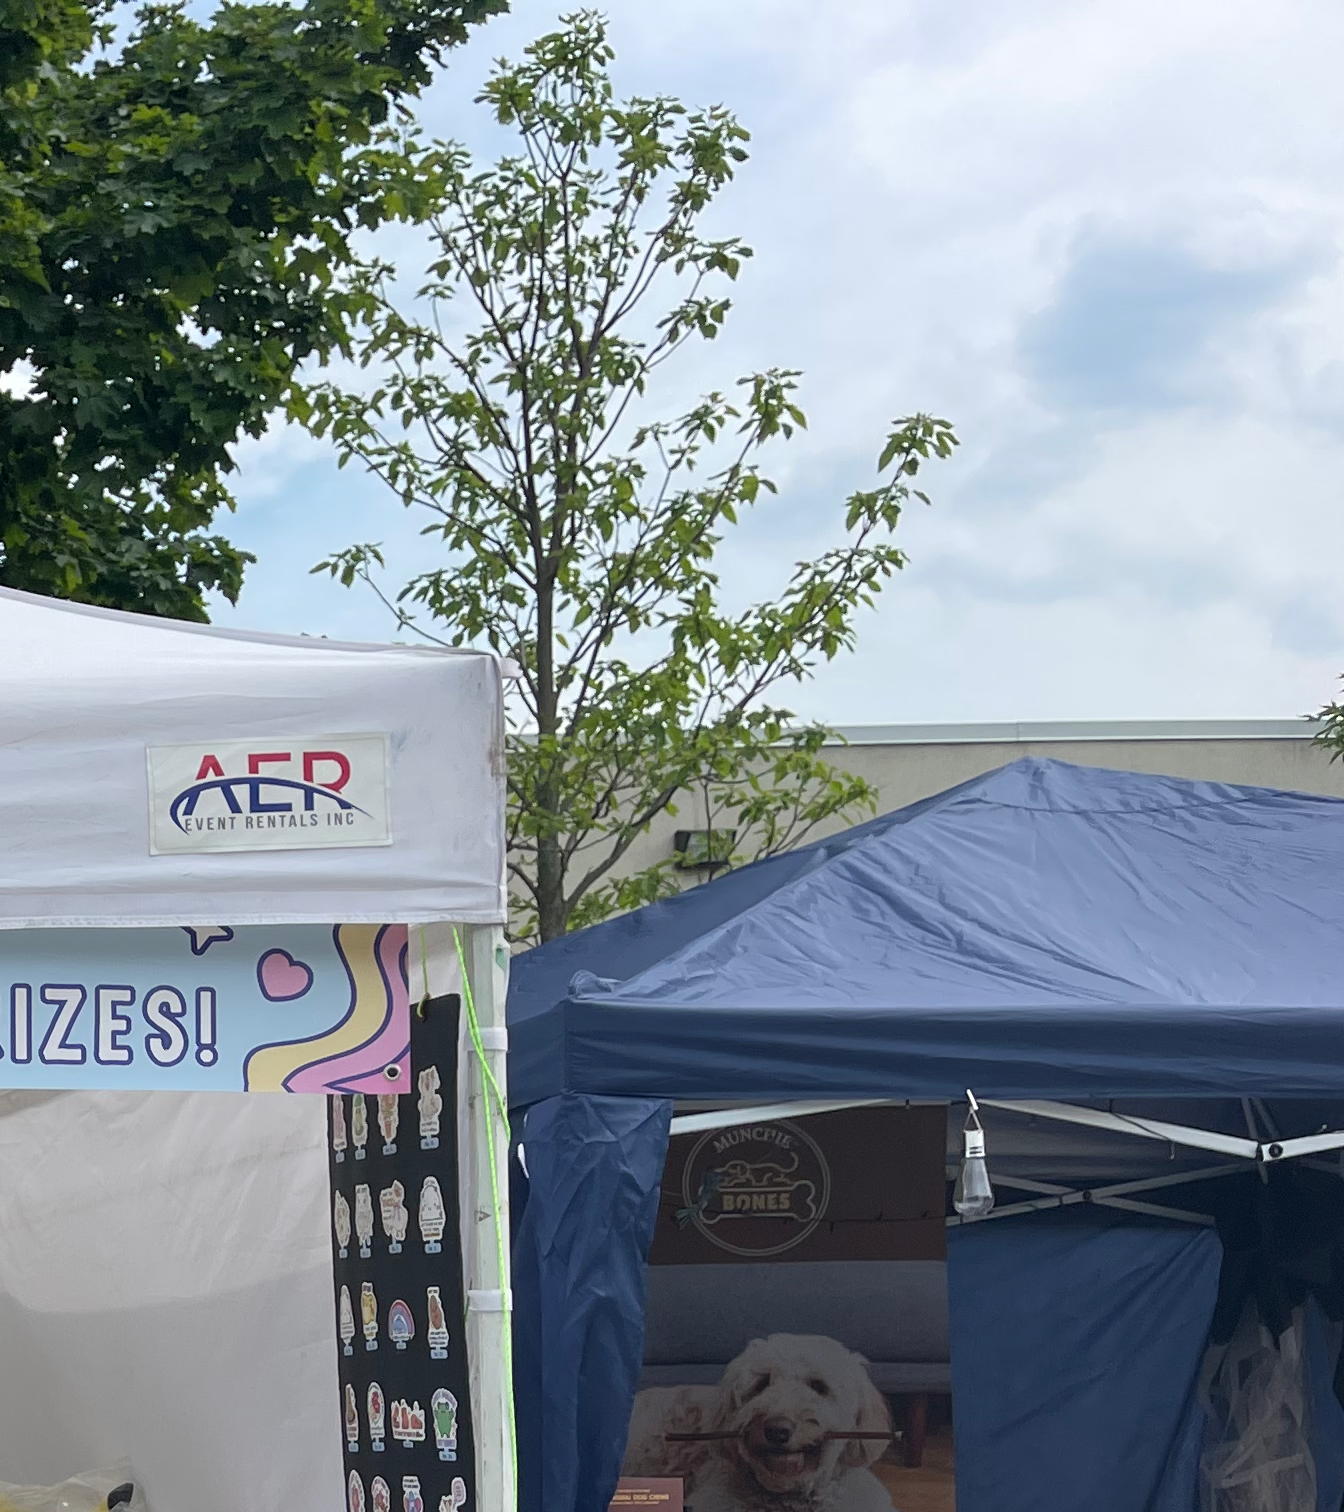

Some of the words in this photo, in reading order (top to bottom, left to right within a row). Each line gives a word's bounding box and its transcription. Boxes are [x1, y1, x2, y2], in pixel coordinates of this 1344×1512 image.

[182, 751, 352, 816] AER
[185, 817, 236, 832] EVENT
[245, 813, 318, 829] RENTALS
[327, 812, 354, 826] INC
[722, 1192, 791, 1212] BONES
